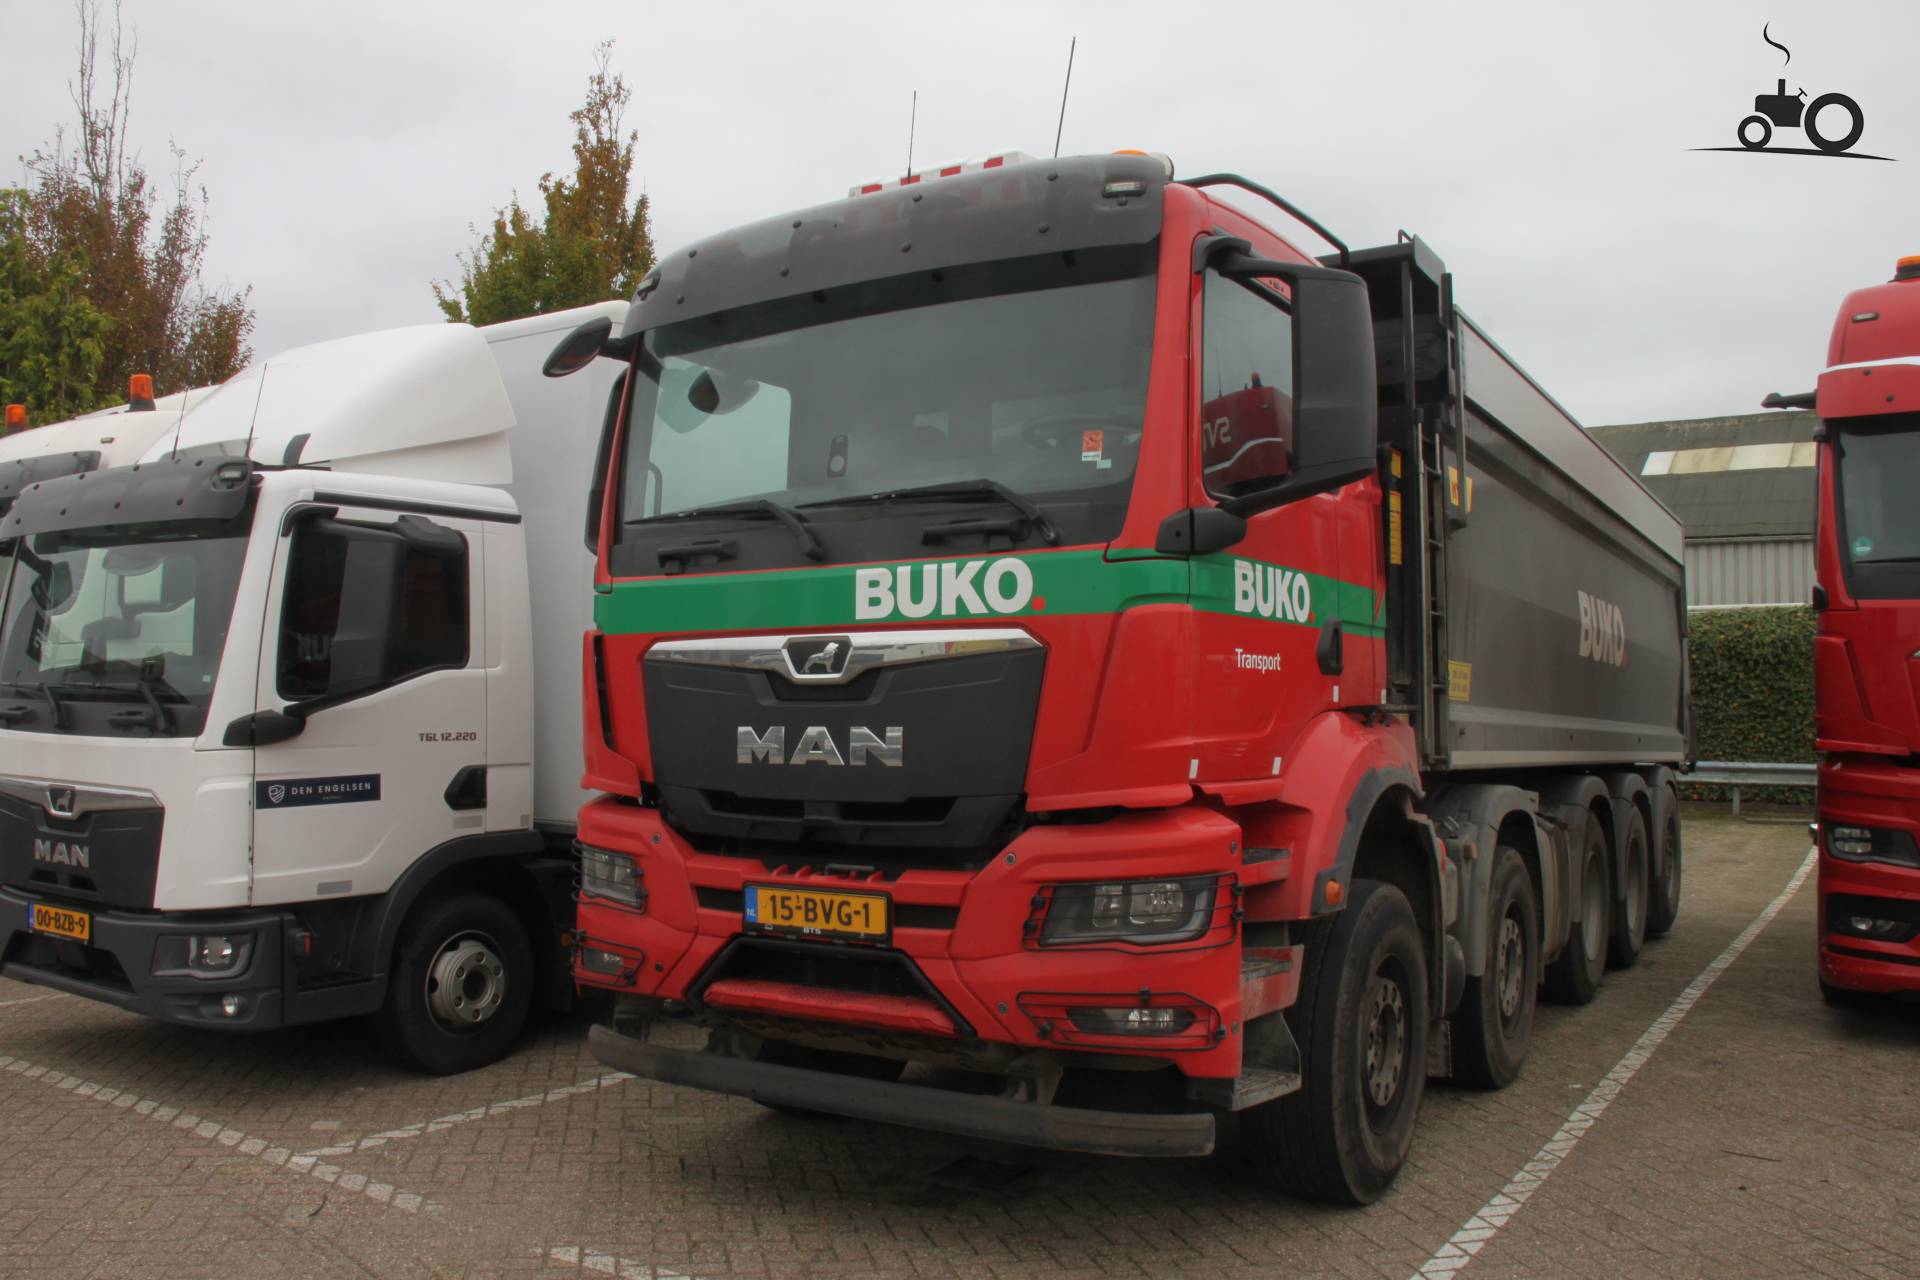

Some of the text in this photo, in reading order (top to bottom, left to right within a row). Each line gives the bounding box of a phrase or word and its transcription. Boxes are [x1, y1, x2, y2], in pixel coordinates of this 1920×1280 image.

[1235, 648, 1281, 674] Transport
[419, 731, 477, 742] TGL 12.220
[737, 726, 903, 767] MAN
[291, 782, 371, 796] DEN ENGELSEN
[34, 838, 89, 869] MAN
[769, 894, 870, 929] 15-BVG-1
